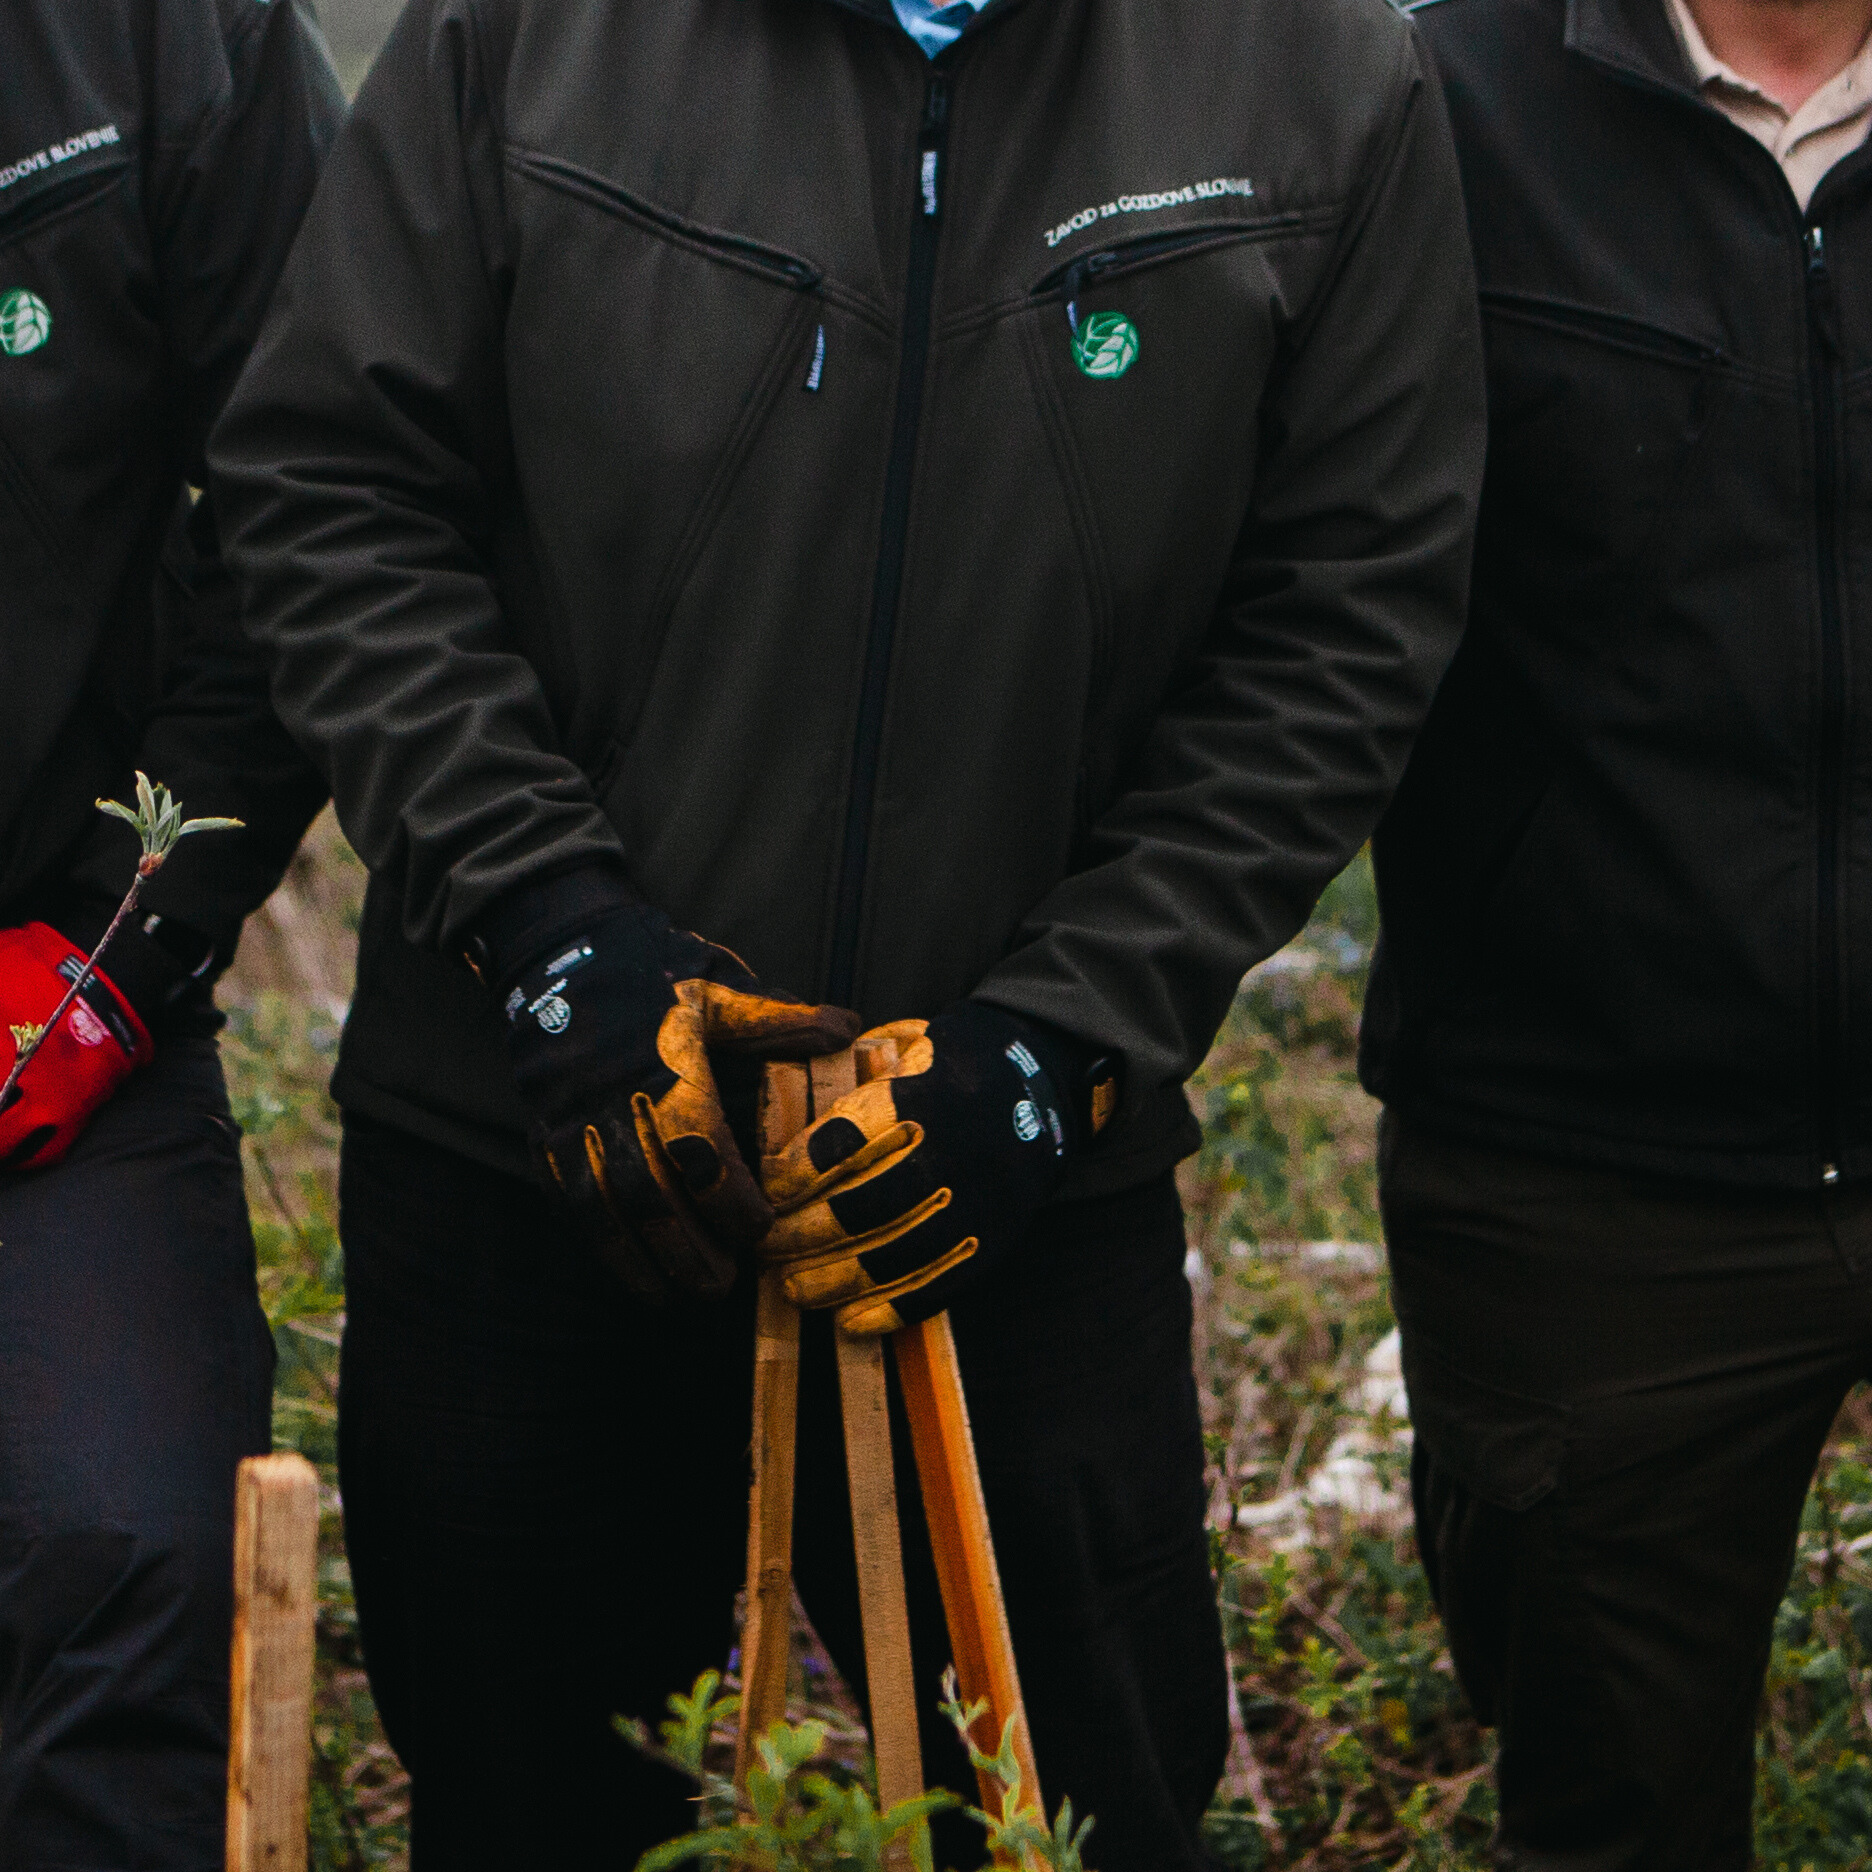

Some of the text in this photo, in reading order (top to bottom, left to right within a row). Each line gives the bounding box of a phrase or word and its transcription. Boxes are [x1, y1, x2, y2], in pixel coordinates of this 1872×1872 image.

[1044, 208, 1098, 247] ZAVOD
[1099, 201, 1119, 218] za
[1117, 185, 1197, 213] GOZDOVE
